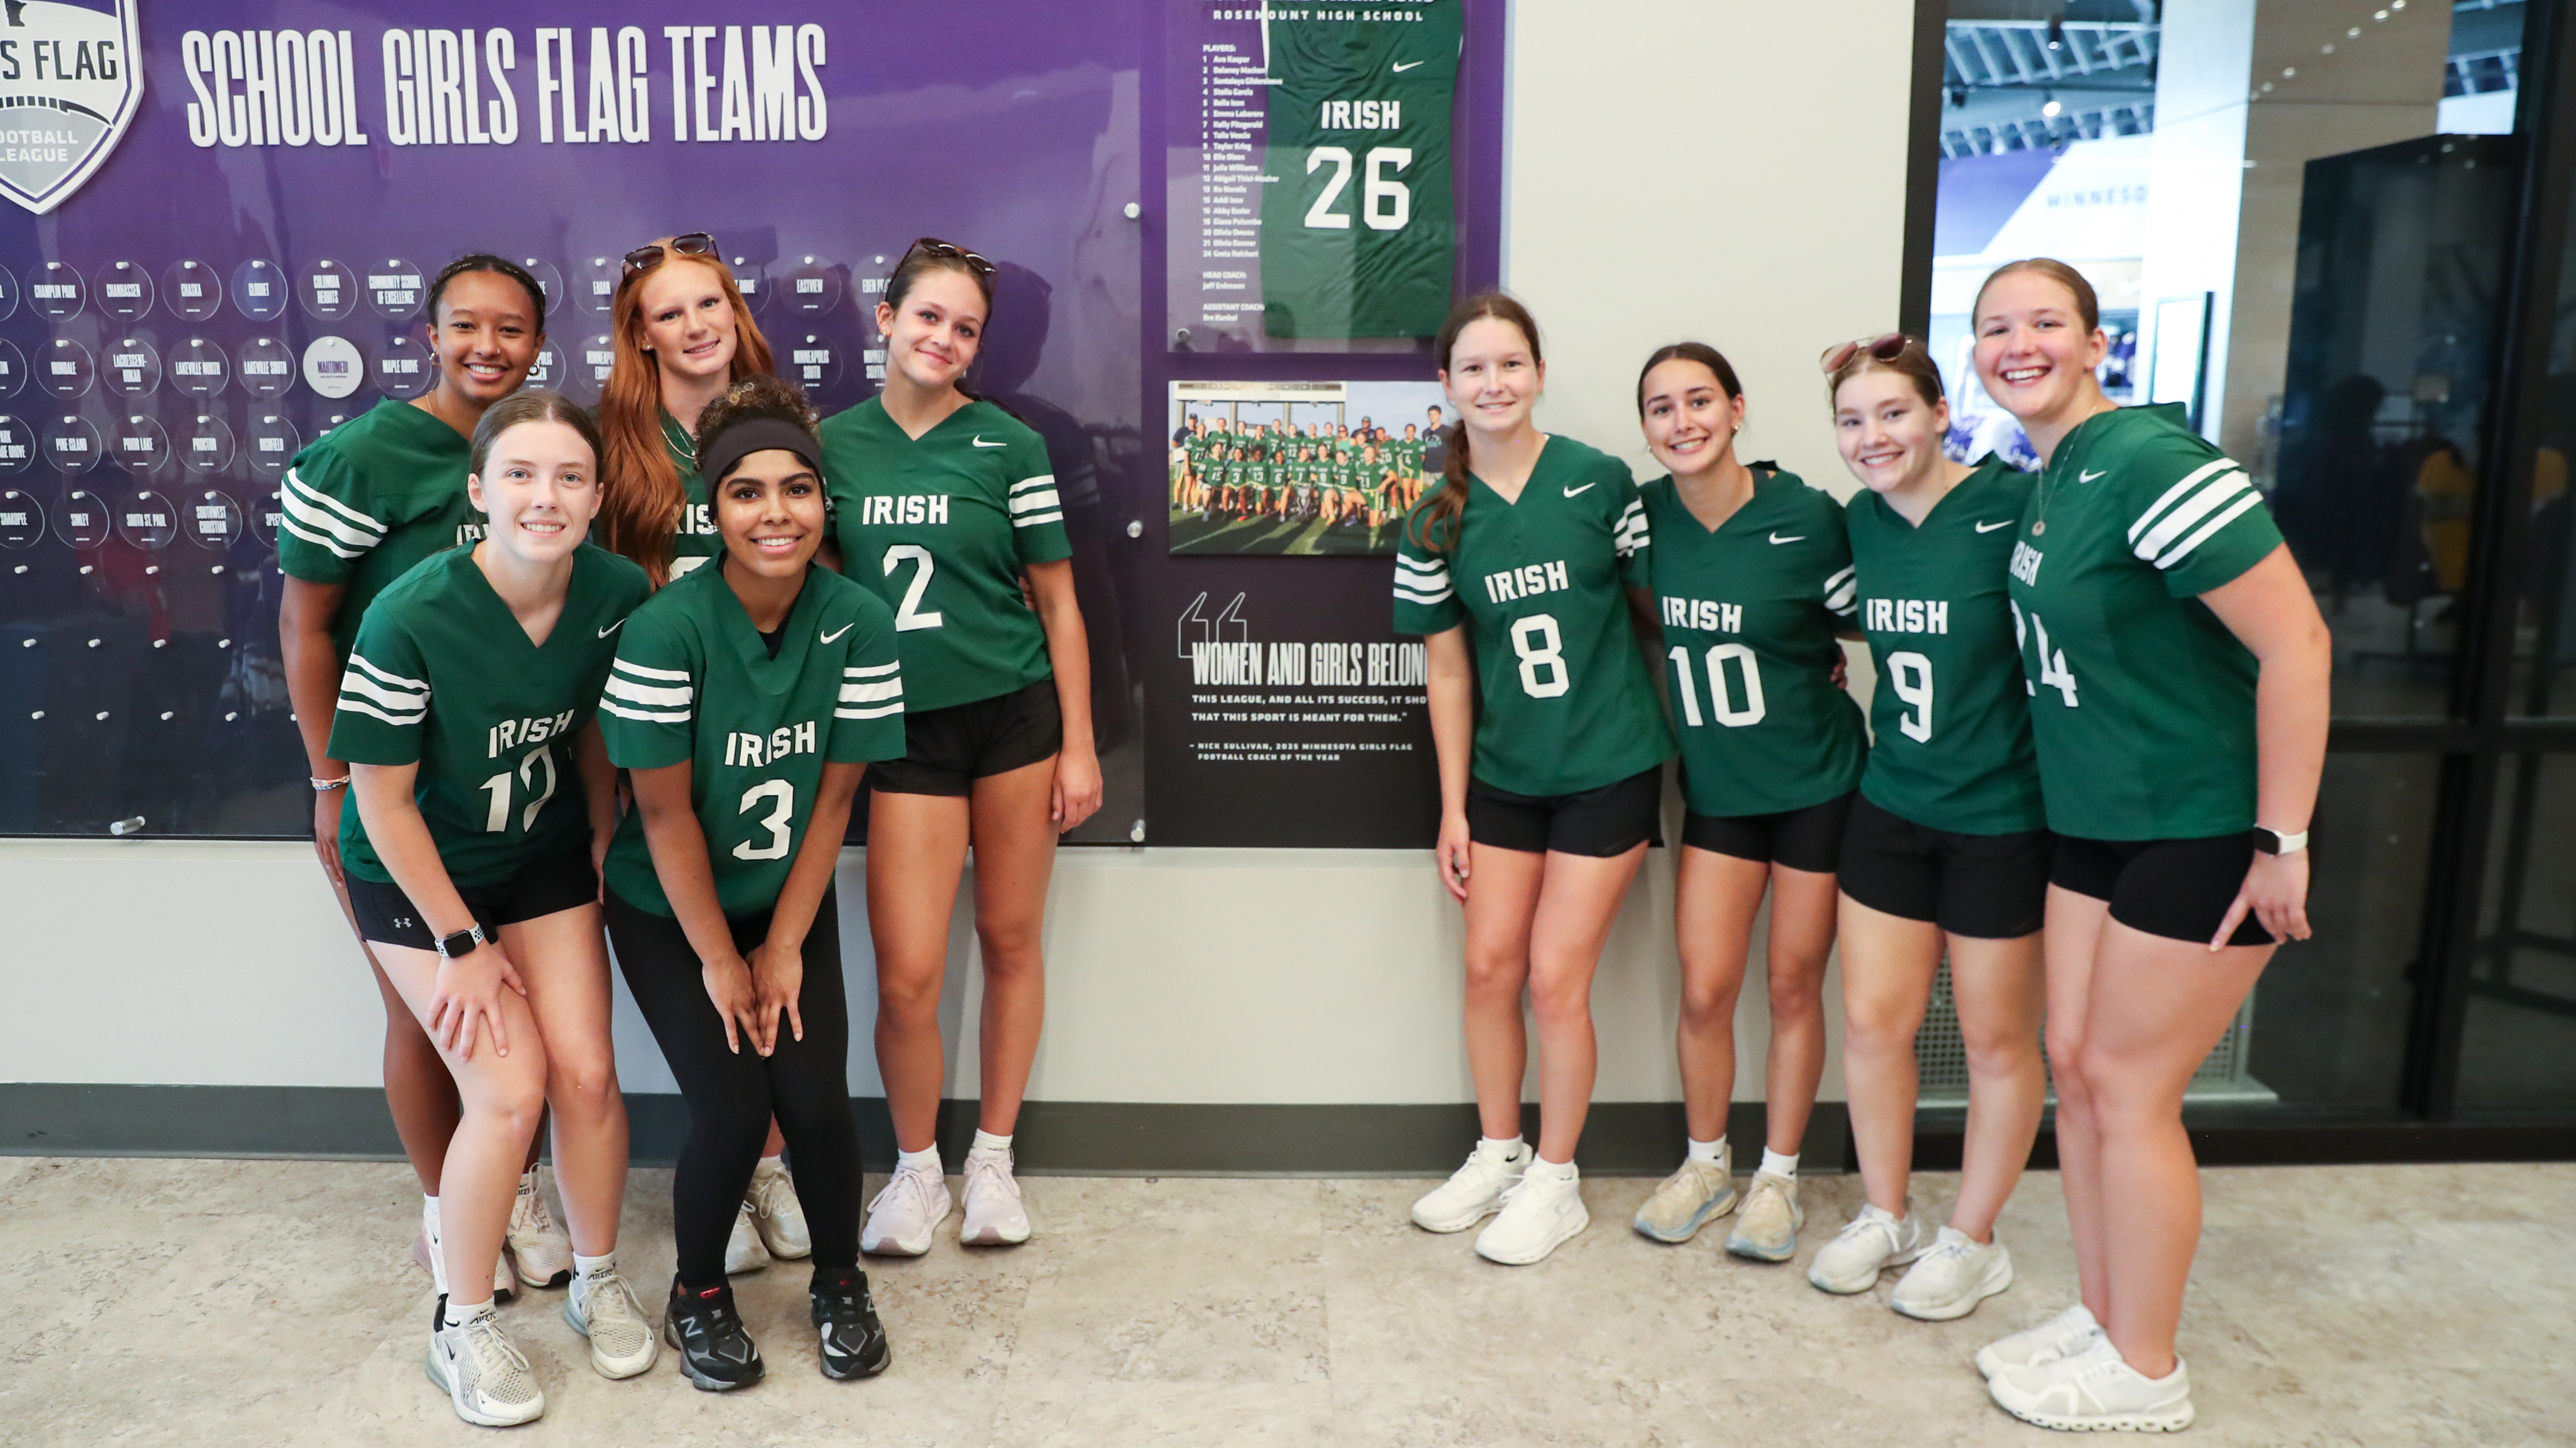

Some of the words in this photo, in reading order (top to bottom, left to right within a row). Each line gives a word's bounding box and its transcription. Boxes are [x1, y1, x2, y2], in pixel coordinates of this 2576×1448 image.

[1214, 10, 1309, 21] ROSEMOUNT
[1317, 11, 1355, 21] HIGH
[1363, 11, 1424, 22] SCHOOL
[1203, 44, 1237, 52] PLAYERS:
[33, 41, 117, 80] FLAG
[1203, 66, 1208, 74] 2
[1213, 66, 1240, 76] Delaney
[182, 29, 367, 148] SCHOOL
[382, 28, 519, 147] GIRLS
[535, 26, 650, 144] FLAG
[664, 24, 828, 142] TEAMS
[1203, 110, 1208, 118] 6
[1213, 110, 1235, 118] Emma
[1321, 100, 1400, 129] IRISH
[1203, 120, 1208, 128] 7
[0, 131, 78, 144] OTBALL
[1213, 142, 1233, 151] Taylor
[1228, 164, 1258, 172] Williams
[1304, 146, 1412, 230] 26
[2047, 184, 2149, 207] WINNESO
[1213, 207, 1230, 216] Abby
[248, 282, 269, 296] CLOQUET
[313, 275, 340, 289] COLUMBIA
[369, 275, 400, 289] COMMUNITY
[401, 275, 421, 289] SCHOOL
[593, 281, 611, 295] EAGAN
[797, 279, 823, 293] EASTVIEW
[34, 285, 61, 298] CHAMPLIN
[61, 285, 76, 298] PARK
[106, 284, 141, 297] CHANHASSEN
[180, 283, 202, 297] CHASKA
[317, 290, 338, 304] HEIGHTS
[377, 290, 384, 304] OF
[385, 290, 415, 304] EXCELLENCE
[1203, 303, 1240, 311] ASSISTANT
[794, 350, 830, 364] MINNEAPOLIS
[175, 362, 202, 375] LAKEVILLE
[203, 362, 221, 375] NORTH
[243, 361, 270, 375] LAKEVILLE
[270, 361, 287, 375] SOUTH
[317, 361, 348, 373] MAHTOMEDI
[382, 359, 401, 373] MAPLE
[401, 359, 419, 373] GROVE
[0, 430, 12, 443] ARK
[56, 438, 68, 451] PINE
[69, 438, 87, 451] ISLAND
[140, 438, 154, 451] LAKE
[196, 506, 226, 519] SOUTHWEST
[862, 495, 948, 525] IRISH
[0, 512, 28, 526] SHAKOPEE
[126, 513, 144, 527] SOUTH
[153, 513, 167, 527] PAUL
[265, 513, 283, 526] SPECT
[199, 520, 227, 534] CHRISTIAN
[882, 544, 943, 632] 2
[1484, 560, 1570, 604] IRISH
[1662, 596, 1743, 634] IRISH
[1866, 598, 1948, 634] IRISH
[1510, 614, 1570, 699] 8
[1192, 642, 1263, 686] WOMEN
[1267, 642, 1306, 686] AND
[1310, 642, 1362, 686] GIRLS
[1367, 643, 1428, 686] BELON
[1668, 643, 1766, 728] 10
[1192, 694, 1217, 704] THIS
[1220, 694, 1266, 705] LEAGUE,
[1268, 695, 1291, 704] AND
[1294, 695, 1315, 704] ALL
[1317, 695, 1335, 704] ITS
[1338, 695, 1388, 705] SUCCESS,
[1391, 696, 1402, 704] IT
[1404, 696, 1428, 705] SHO
[1886, 651, 1934, 744] 9
[1192, 713, 1220, 722] THAT
[1222, 713, 1248, 722] THIS
[1250, 713, 1286, 722] SPORT
[1289, 713, 1300, 722] IS
[1303, 713, 1341, 722] MEANT
[1343, 713, 1364, 722] FOR
[488, 709, 575, 759] IRISH
[725, 721, 815, 767] IRISH
[1224, 743, 1273, 751] SULLIVAN,
[732, 779, 794, 860] 3
